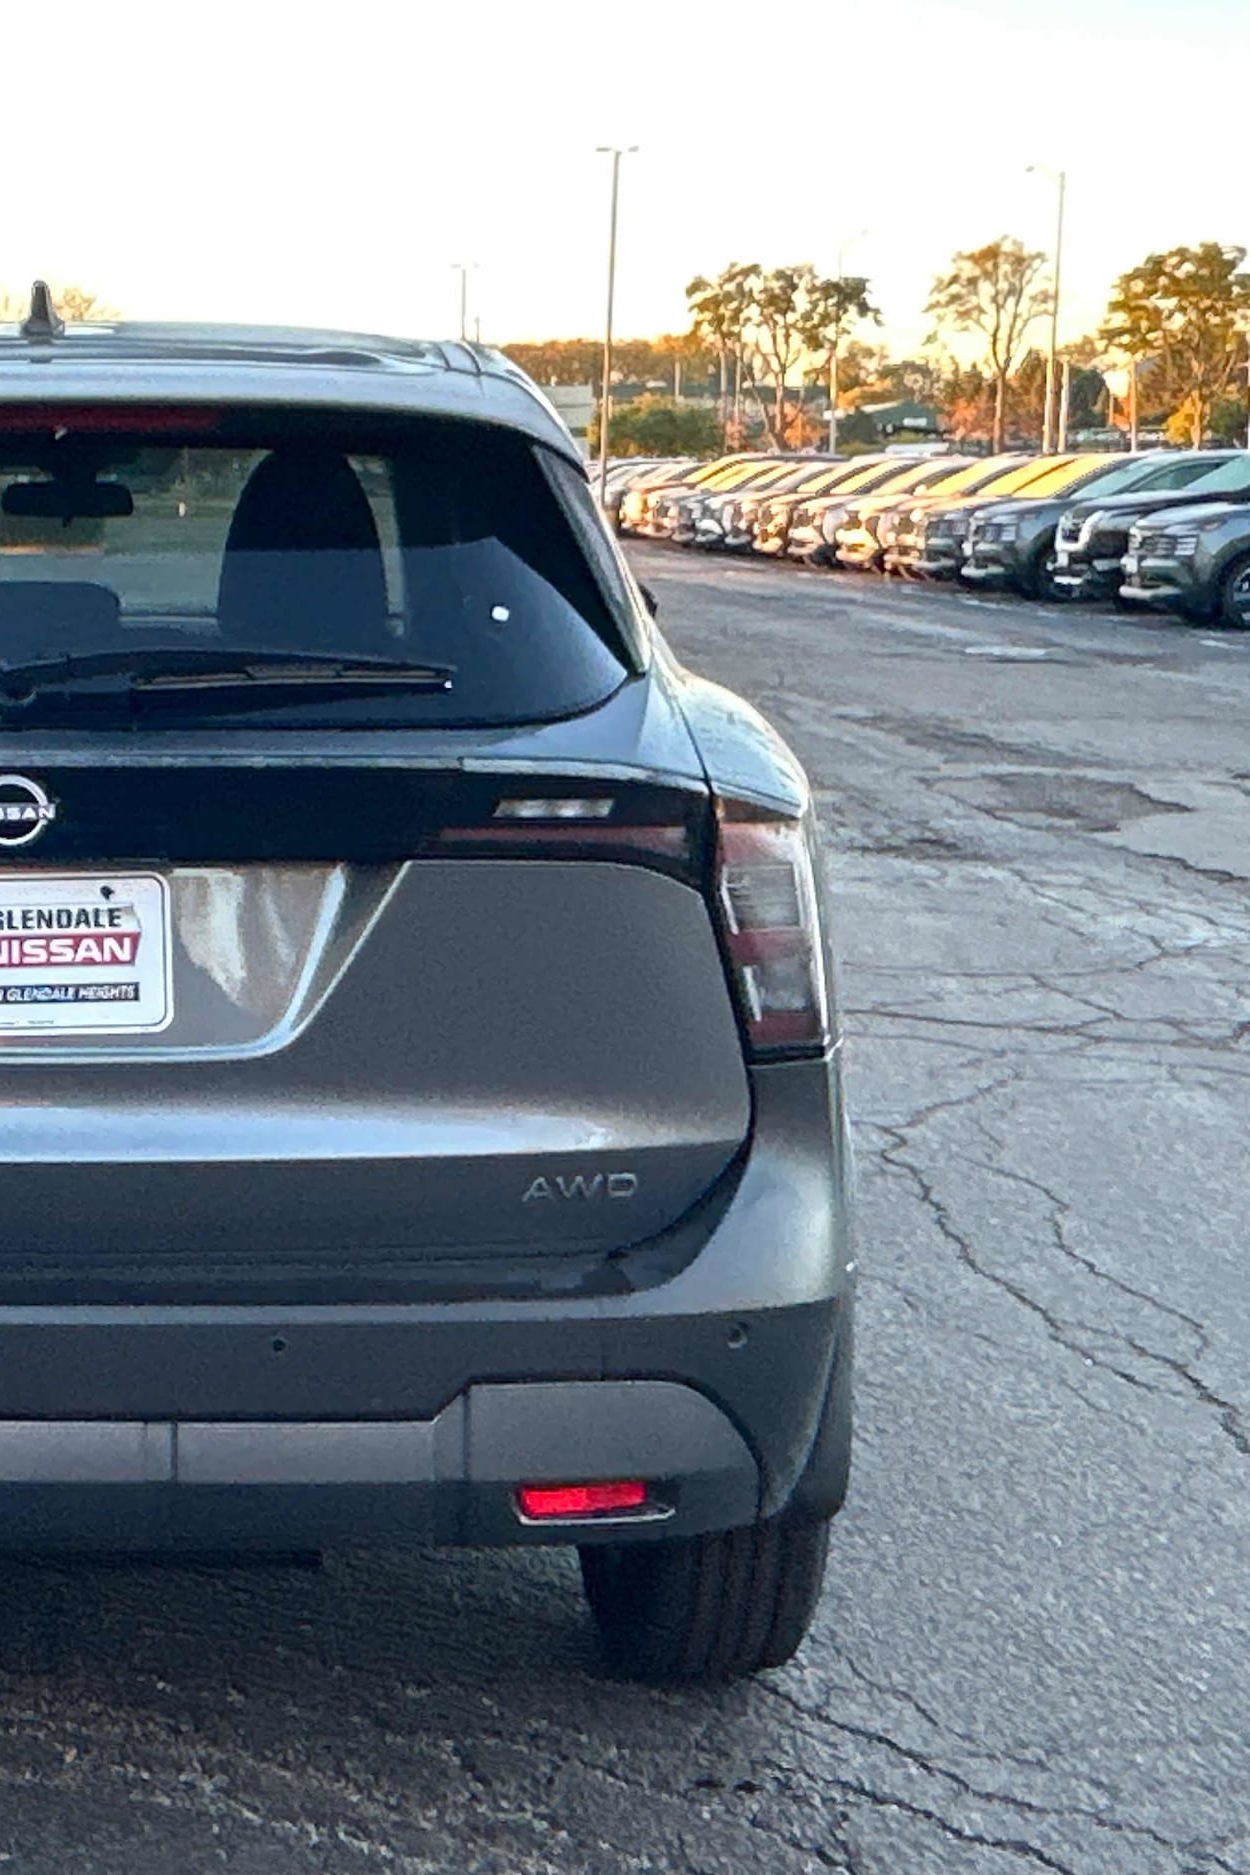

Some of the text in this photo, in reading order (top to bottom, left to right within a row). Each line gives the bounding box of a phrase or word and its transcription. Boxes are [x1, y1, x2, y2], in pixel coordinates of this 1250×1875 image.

[6, 987, 75, 1001] GLENDALE
[78, 985, 136, 1000] HEIGHTS
[522, 1172, 638, 1202] AWD
